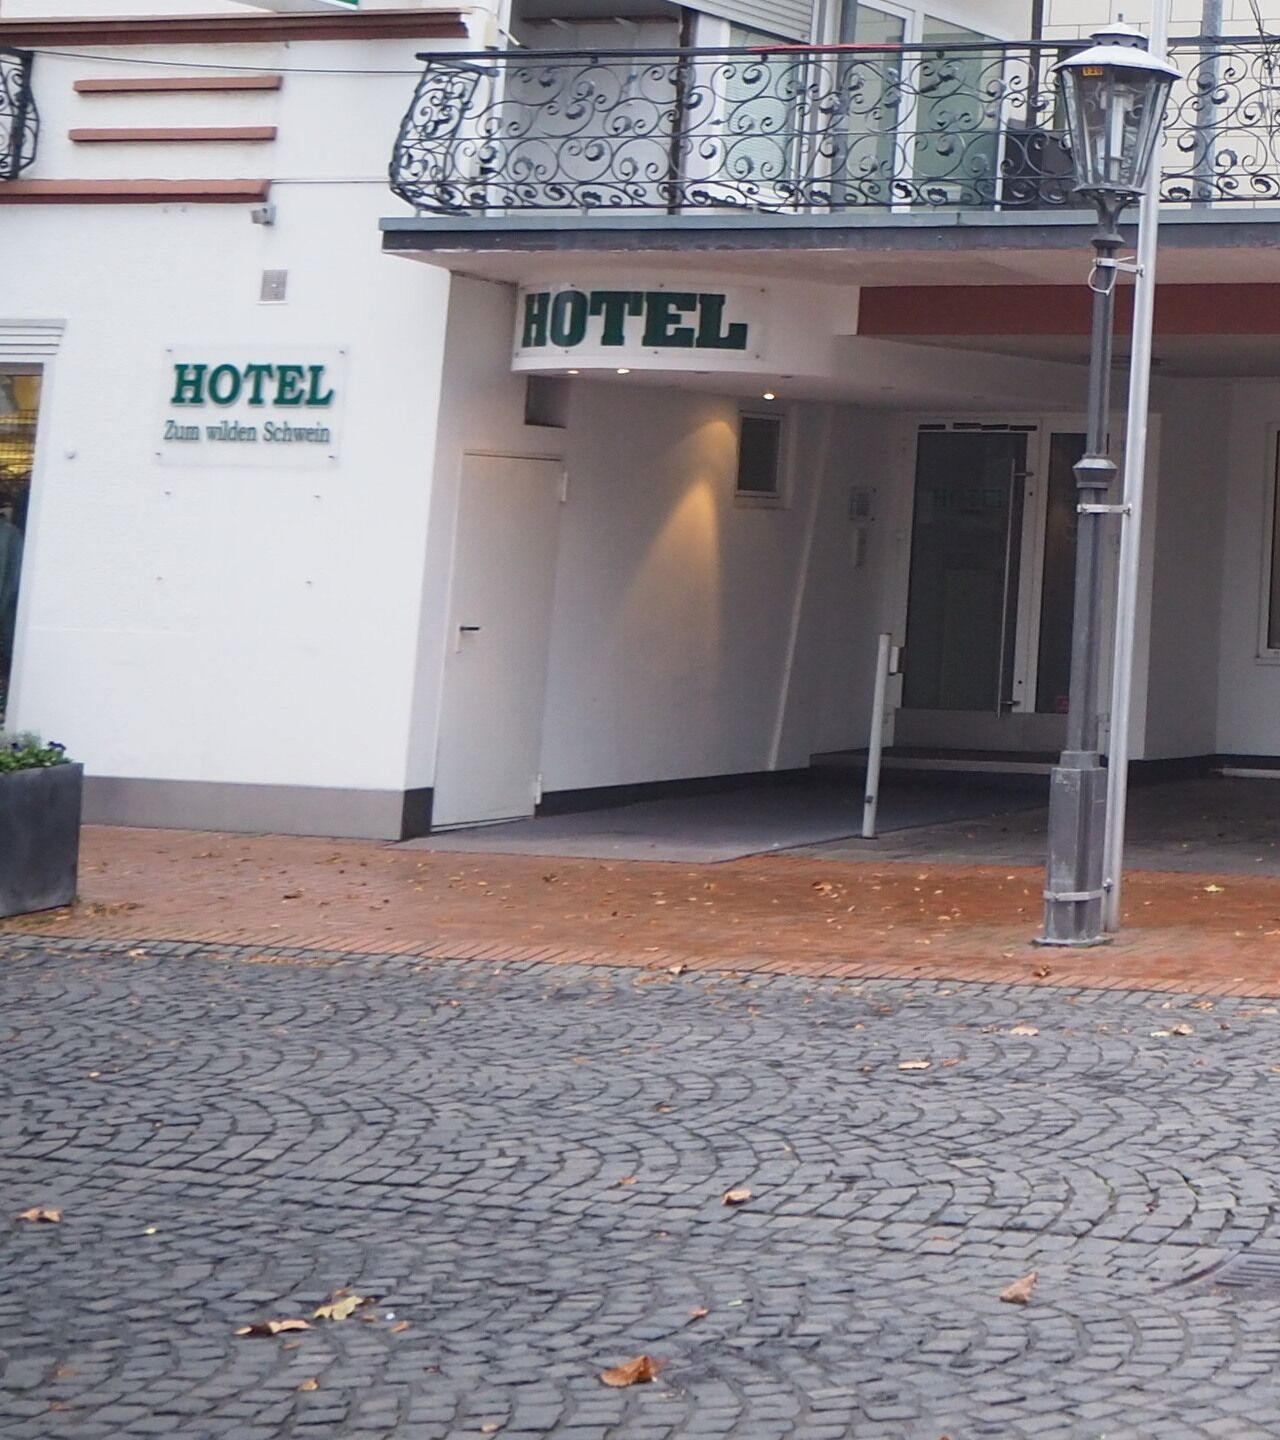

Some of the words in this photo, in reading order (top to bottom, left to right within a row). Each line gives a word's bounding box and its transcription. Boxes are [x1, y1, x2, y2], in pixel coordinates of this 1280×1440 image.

[521, 290, 748, 350] HOTEL
[170, 363, 334, 406] HOTEL
[163, 419, 200, 441] Zum
[206, 420, 257, 442] wilden
[263, 421, 330, 443] Schwein
